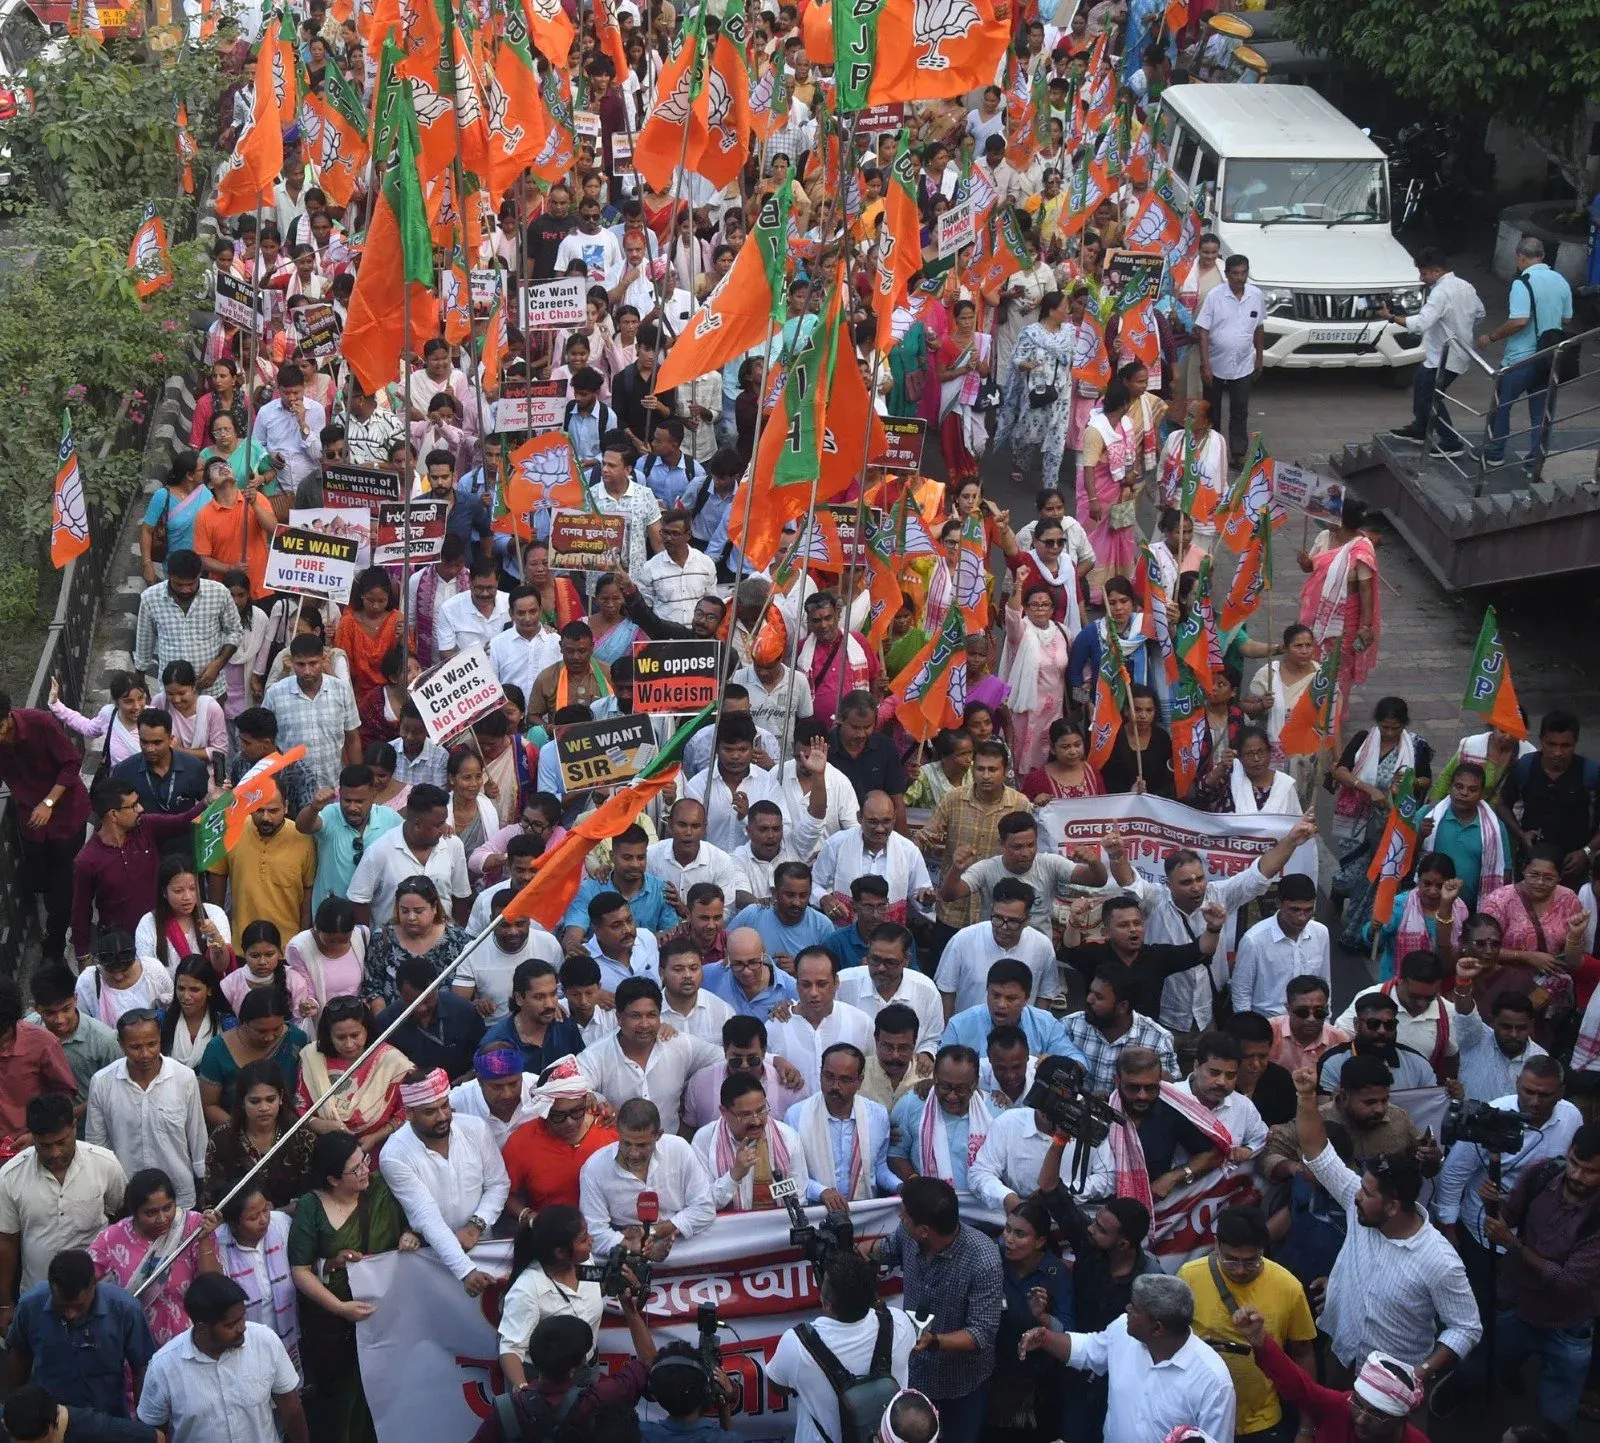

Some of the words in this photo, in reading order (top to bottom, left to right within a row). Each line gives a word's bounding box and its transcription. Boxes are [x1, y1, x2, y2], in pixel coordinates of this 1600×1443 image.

[1113, 256, 1134, 264] INDIA
[224, 276, 236, 288] We
[238, 283, 254, 298] Wan
[528, 289, 546, 298] We
[549, 285, 578, 297] Want
[530, 298, 578, 310] Careers,
[528, 311, 546, 321] Not
[549, 309, 583, 320] Chaos
[325, 470, 376, 484] Beaware
[379, 477, 391, 487] of
[351, 484, 398, 498] NATIONAL
[282, 535, 305, 551] WE
[309, 540, 350, 558] WANT
[294, 558, 326, 573] PURE
[278, 568, 315, 583] VOTER
[318, 574, 344, 587] LIST
[637, 658, 660, 674] We
[663, 656, 715, 675] oppose
[420, 682, 443, 700] We
[443, 656, 479, 685] Want
[430, 676, 486, 714] Careers,
[637, 682, 714, 704] Wokeism
[432, 709, 457, 732] Not
[457, 683, 498, 715] Chaos
[565, 737, 592, 753] WE
[595, 725, 643, 747] WANT
[567, 759, 612, 782] SIR
[1067, 823, 1103, 836] দেশৰ
[775, 1181, 795, 1196] ANI
